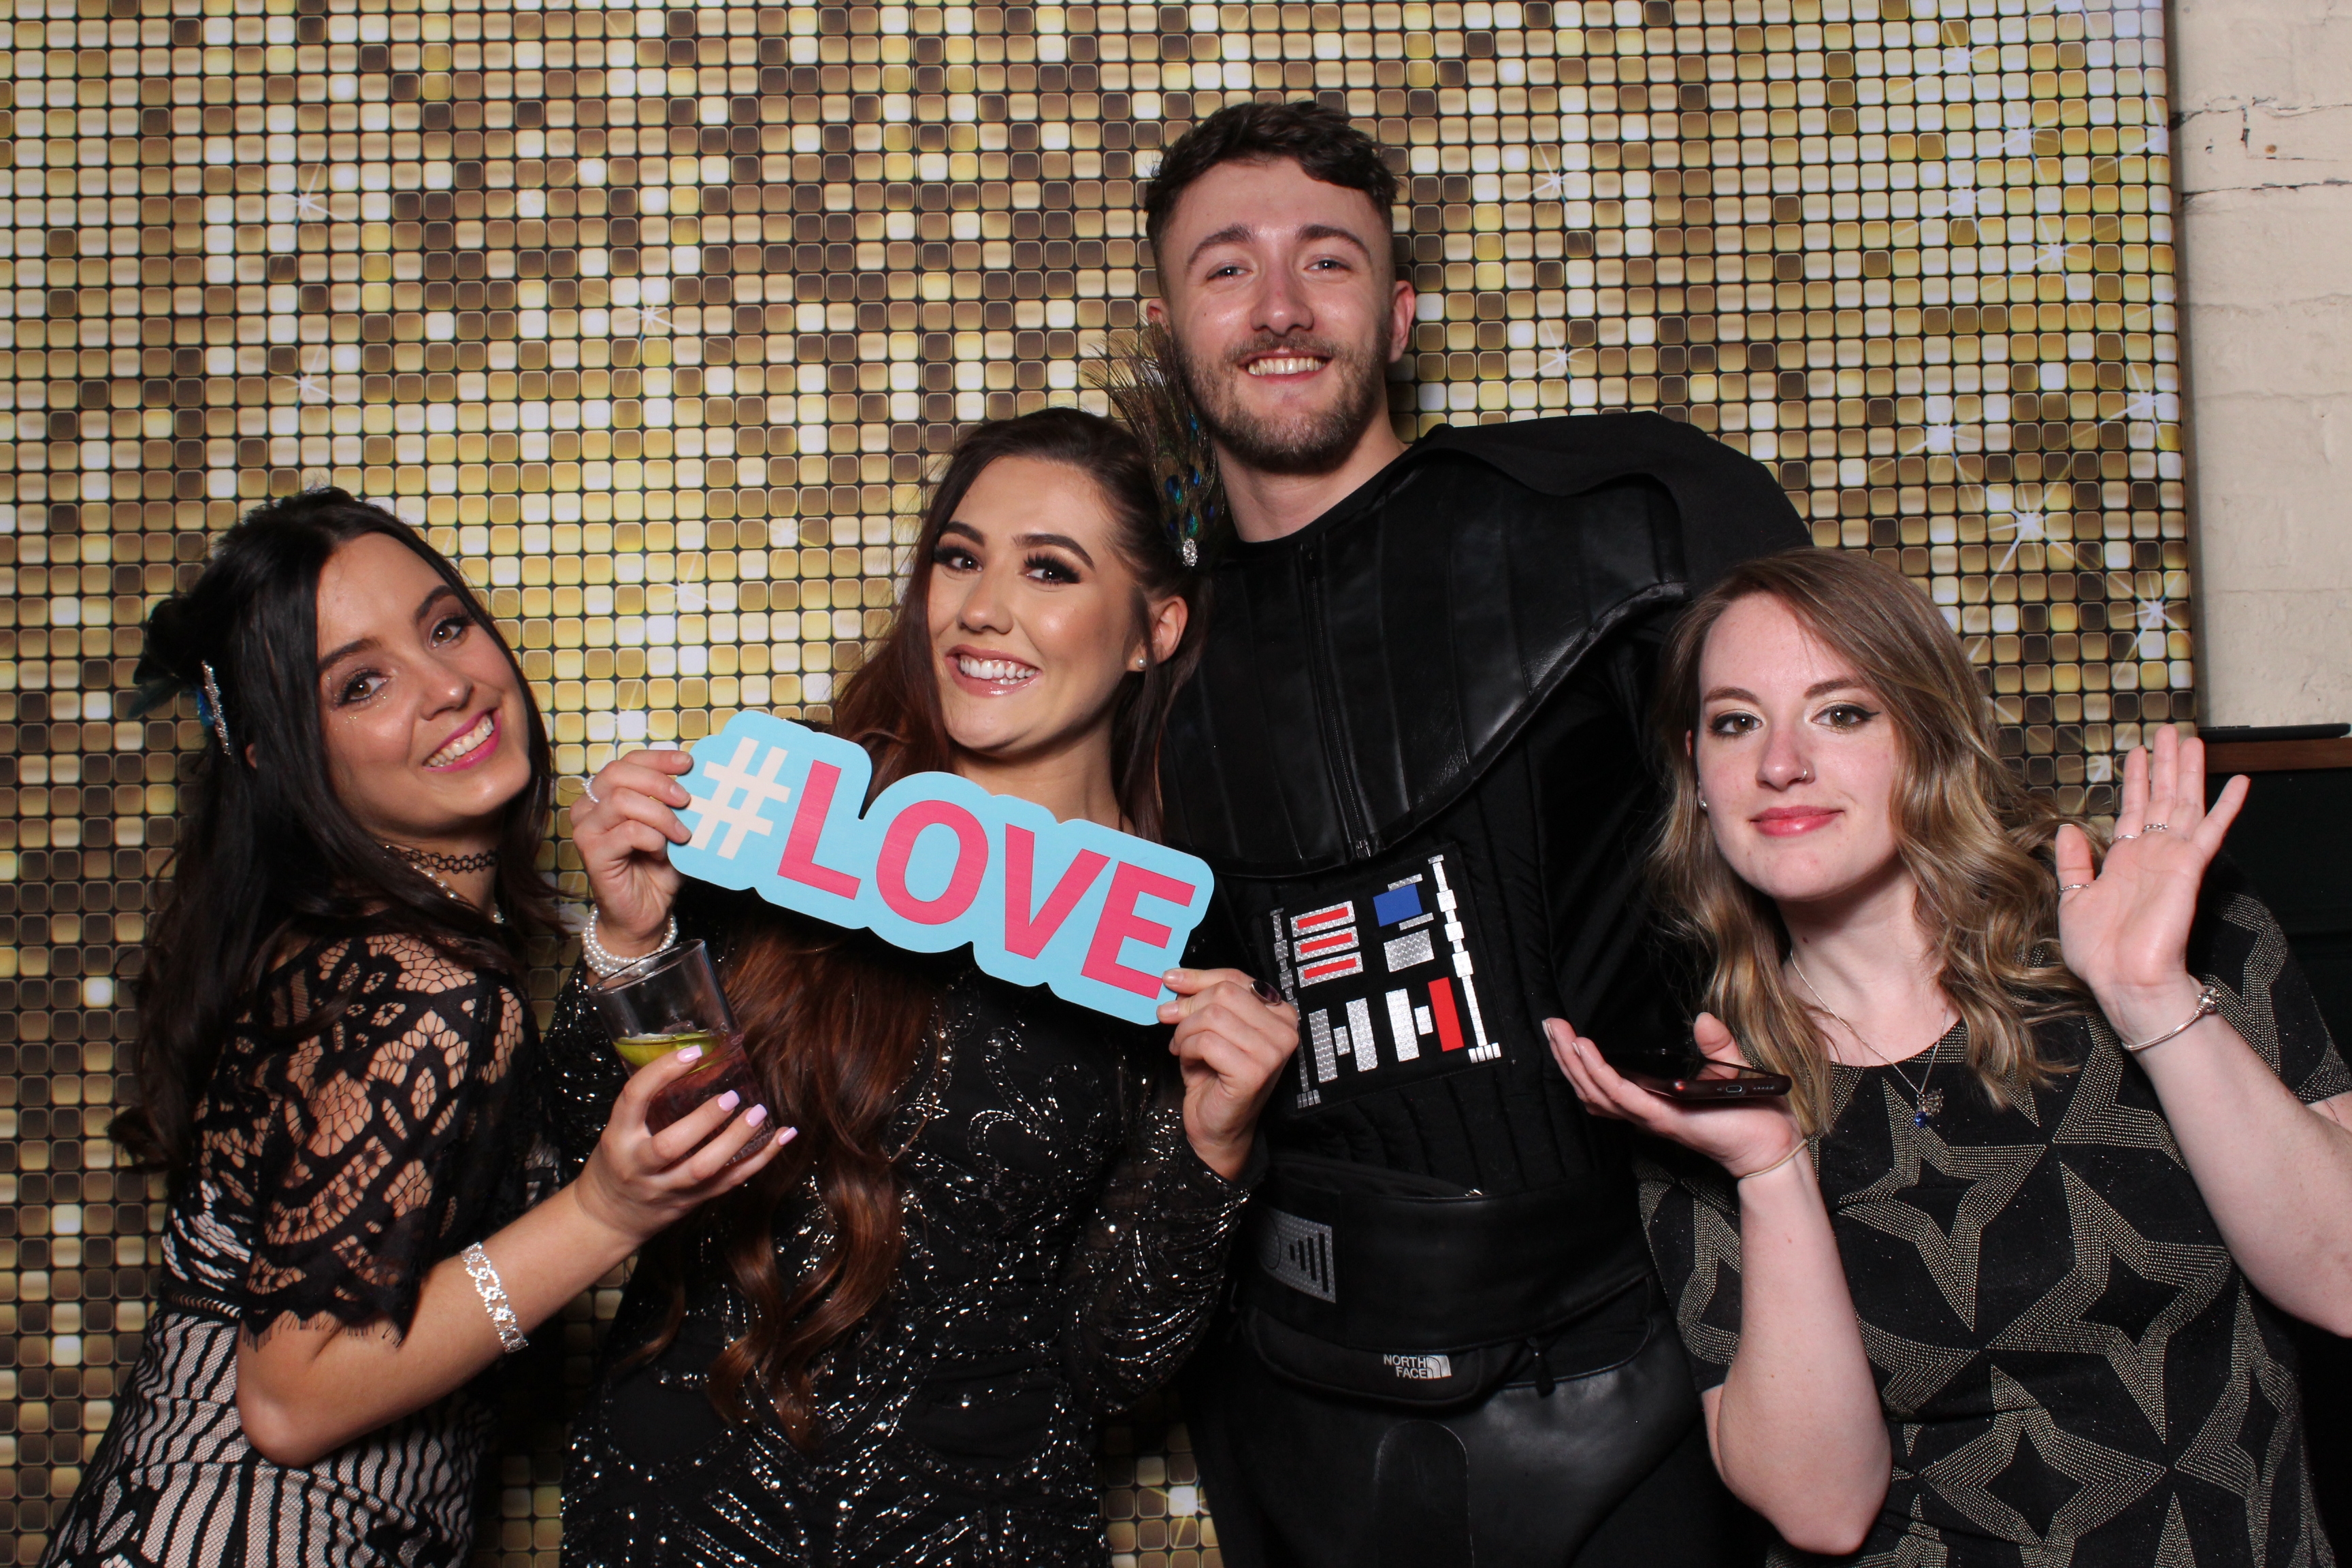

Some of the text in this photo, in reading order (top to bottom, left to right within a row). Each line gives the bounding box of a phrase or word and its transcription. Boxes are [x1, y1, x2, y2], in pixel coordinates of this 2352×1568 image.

[684, 736, 1196, 1000] #LOVE
[1383, 1354, 1426, 1368] NORTH
[1396, 1366, 1427, 1379] FACE
